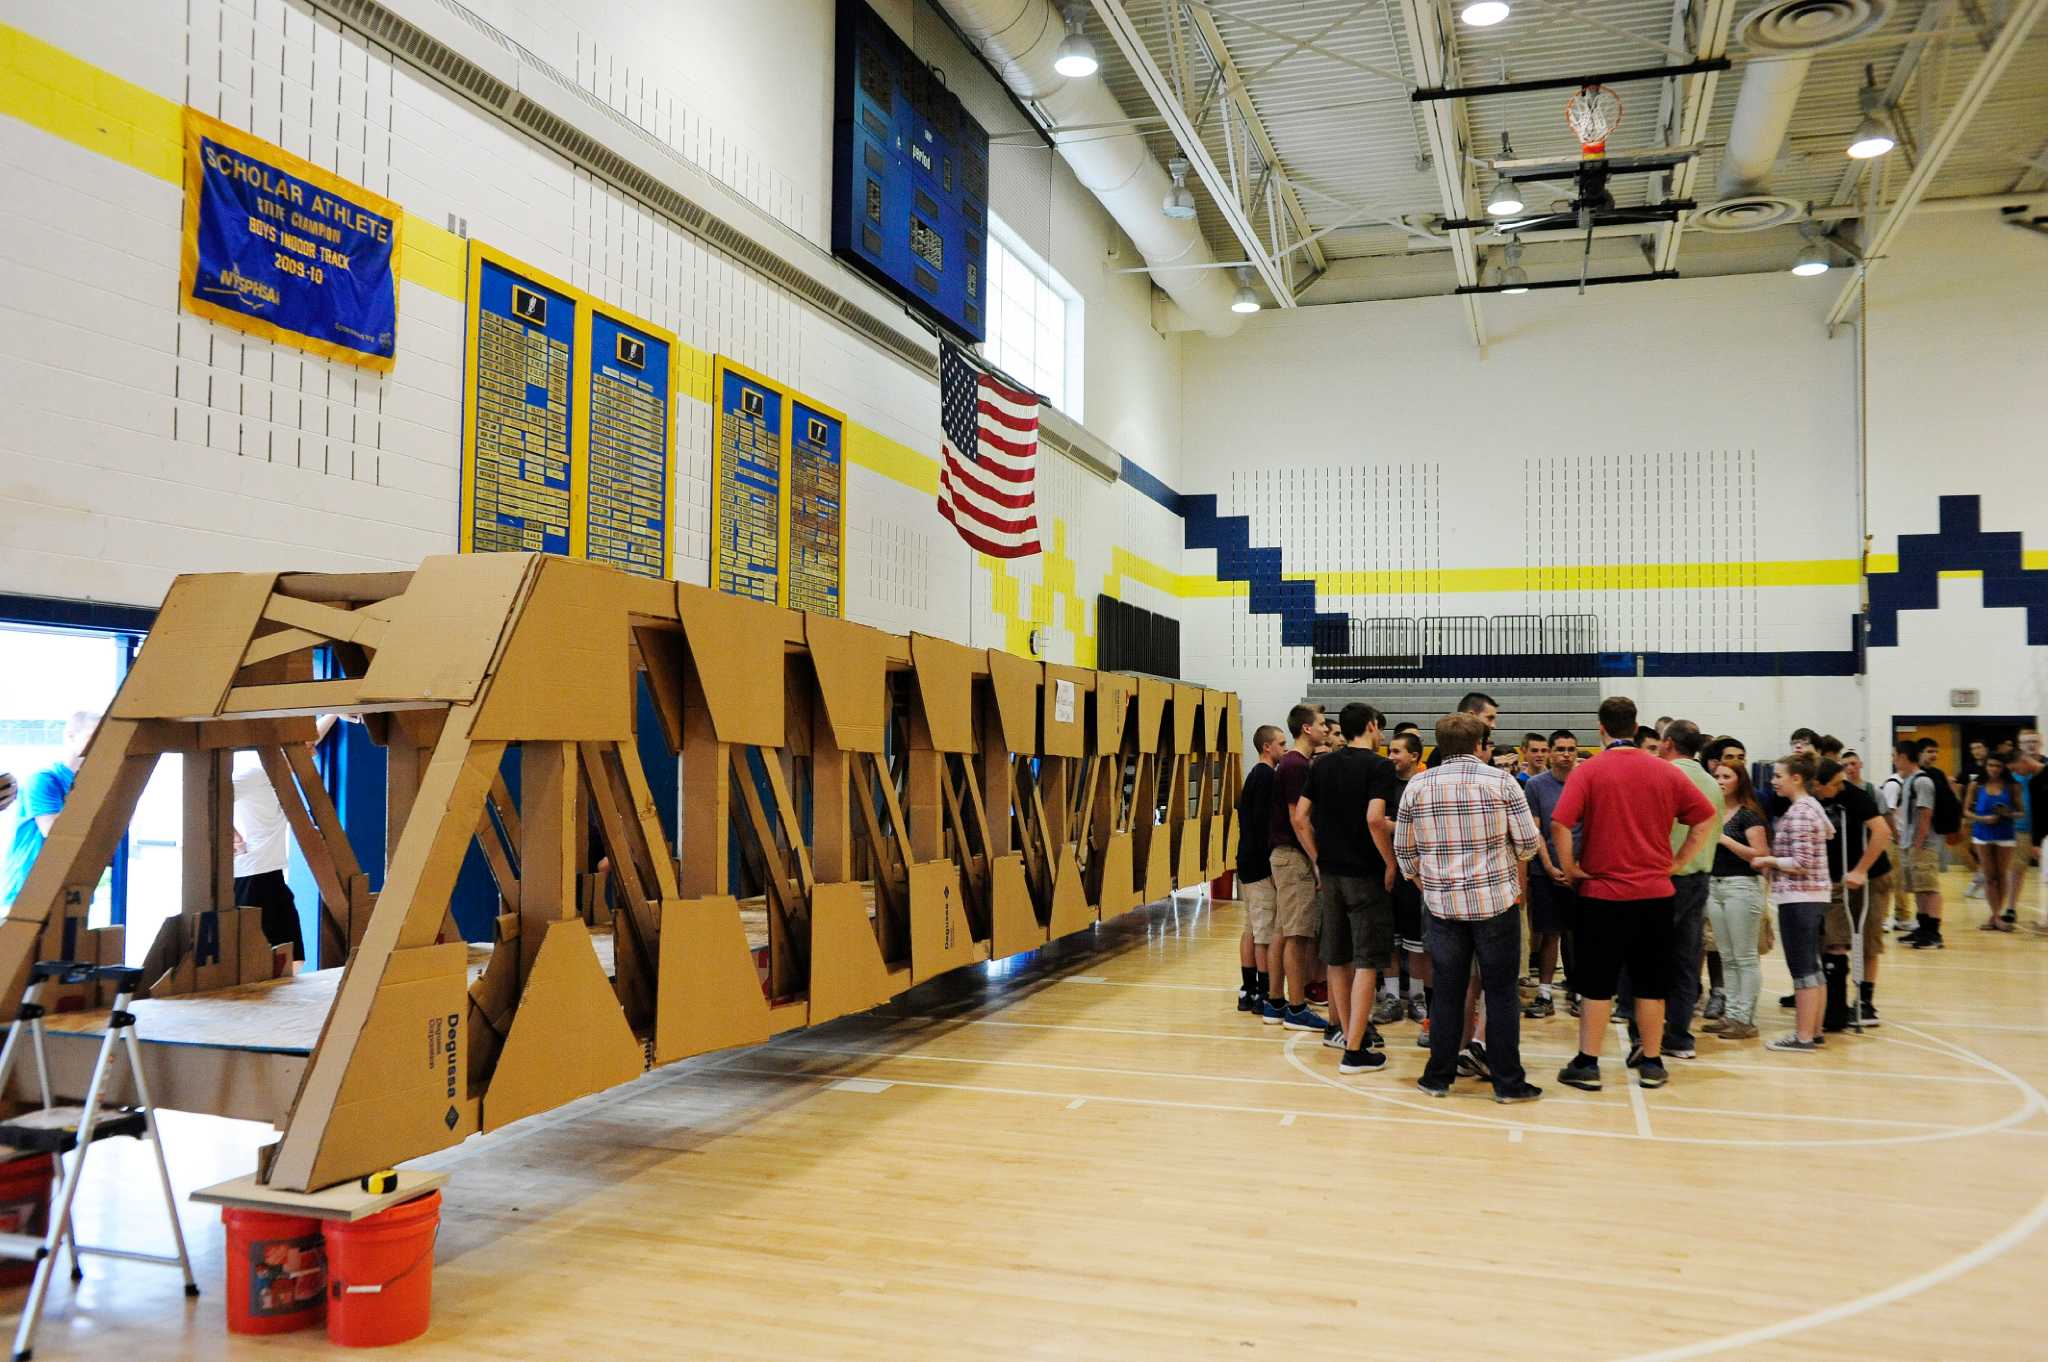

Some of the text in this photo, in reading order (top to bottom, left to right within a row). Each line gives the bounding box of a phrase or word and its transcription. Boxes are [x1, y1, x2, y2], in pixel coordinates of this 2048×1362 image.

[205, 145, 388, 245] SCHOLAR ATHLETE
[248, 215, 349, 270] BOYS INDOOR TRACK
[291, 211, 341, 244] CHAMPION
[274, 252, 324, 285] 2009-10
[445, 1013, 459, 1099] Degussa
